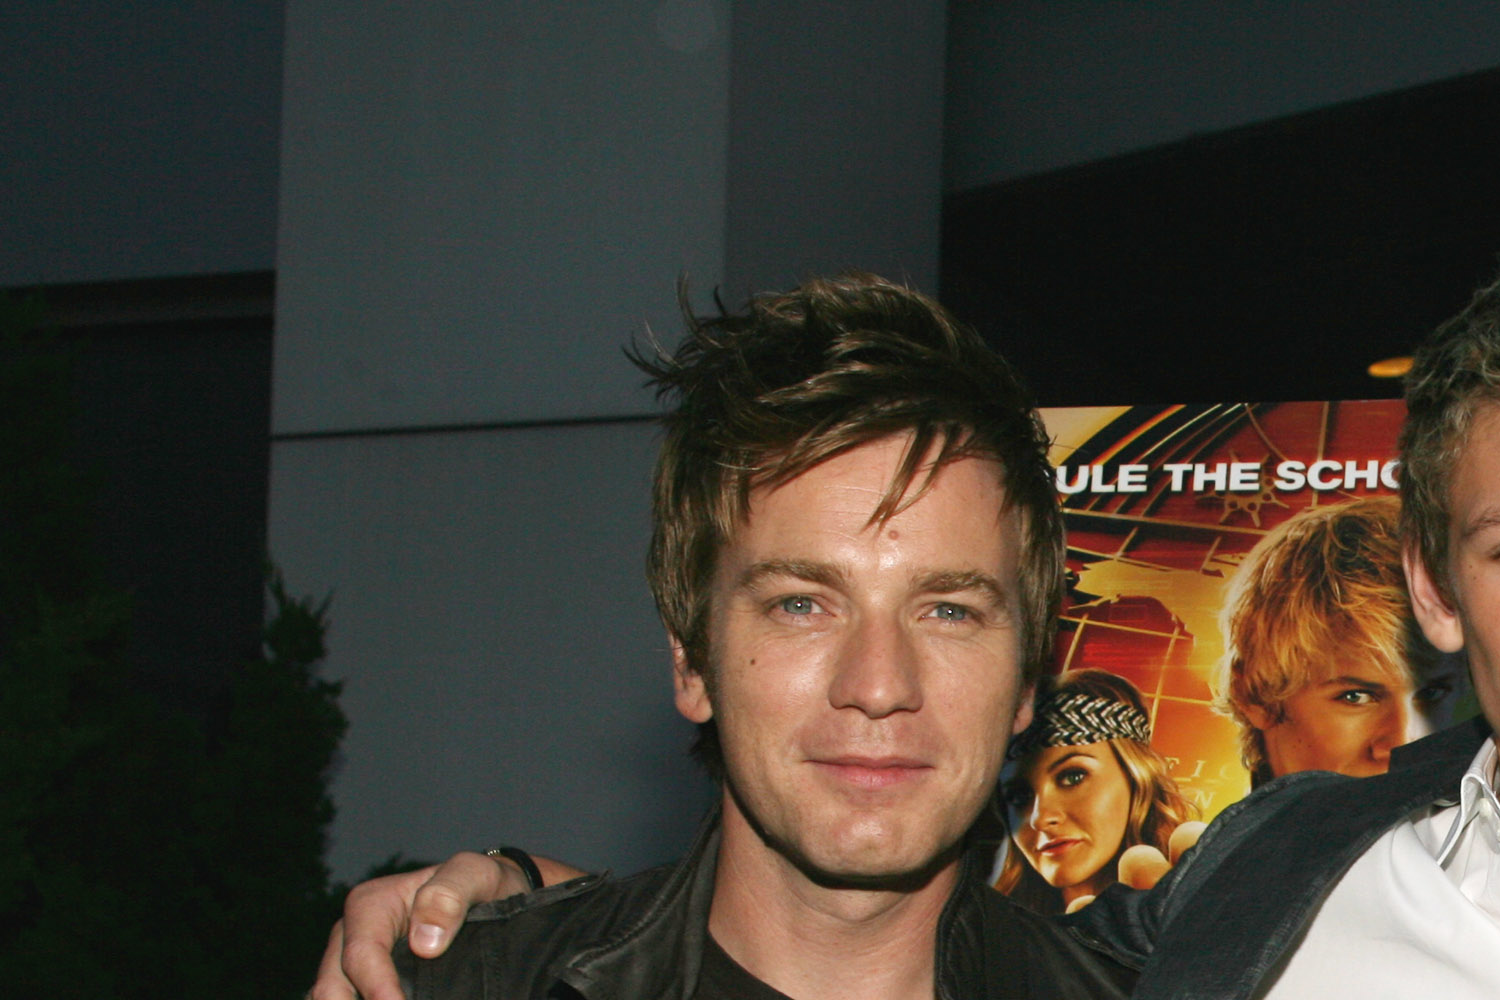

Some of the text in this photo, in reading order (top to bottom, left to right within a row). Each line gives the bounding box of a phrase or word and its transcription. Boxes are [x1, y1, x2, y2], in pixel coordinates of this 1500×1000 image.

[1056, 464, 1148, 494] ULE
[1163, 462, 1260, 492] THE
[1275, 459, 1401, 491] SCHO
